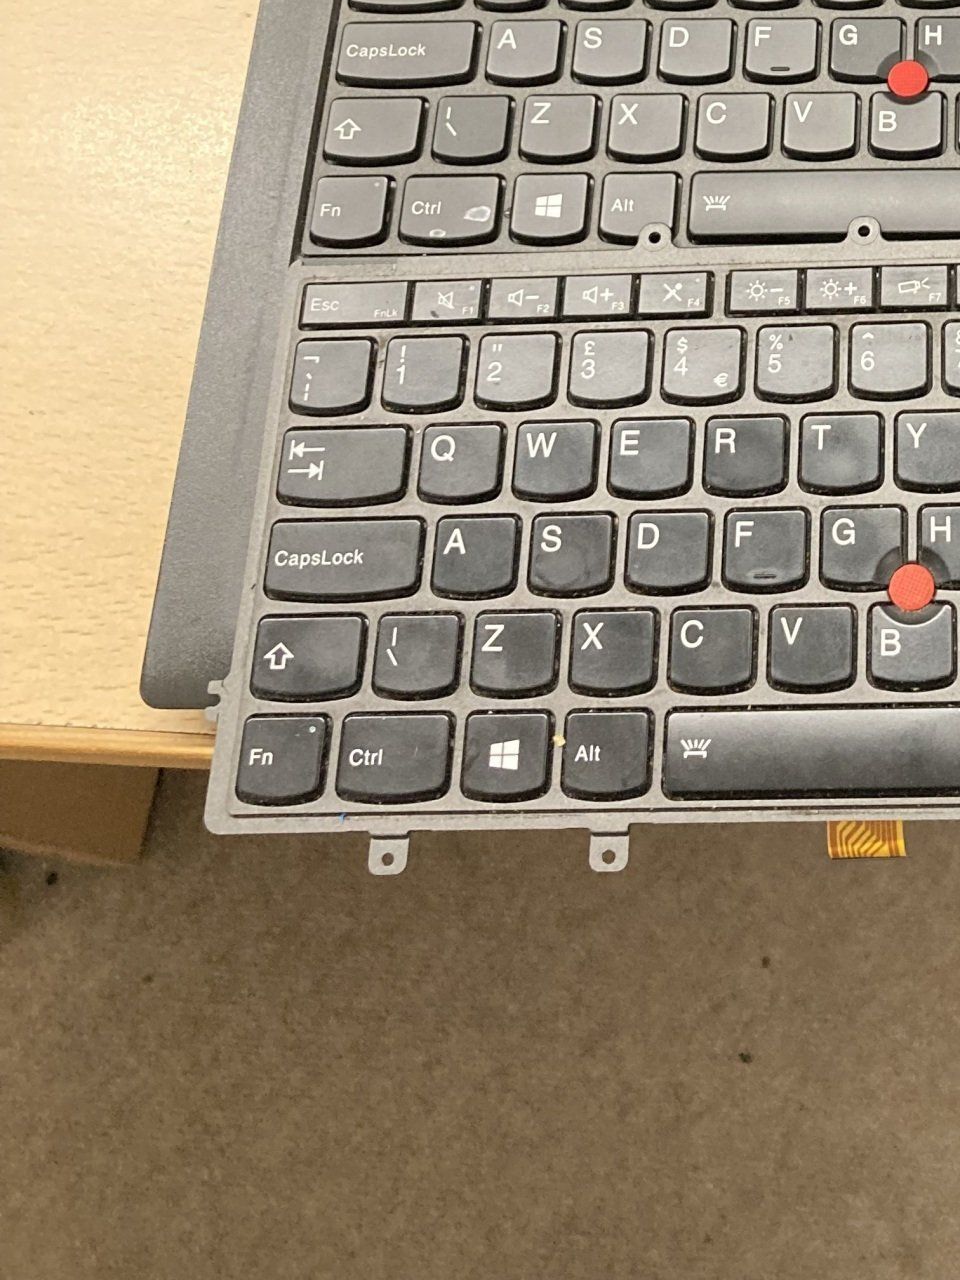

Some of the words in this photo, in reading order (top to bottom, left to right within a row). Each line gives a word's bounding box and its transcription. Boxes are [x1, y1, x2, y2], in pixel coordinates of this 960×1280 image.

[496, 28, 517, 50] A
[583, 27, 603, 49] S
[669, 26, 690, 48] D
[754, 26, 772, 47] F
[838, 24, 858, 46] G
[924, 24, 942, 46] H
[346, 43, 426, 60] CapsLock
[530, 102, 552, 124] Z
[618, 103, 639, 125] X
[705, 101, 727, 125] C
[793, 100, 813, 123] V
[878, 110, 897, 132] B
[319, 203, 341, 217] Fn
[411, 200, 442, 215] Ctrl
[610, 198, 634, 212] Alt
[310, 297, 340, 312] Esc
[536, 303, 550, 314] F2
[611, 301, 625, 311] F3
[687, 297, 700, 308] F4
[777, 295, 791, 306] F5
[853, 295, 867, 305] F6
[928, 292, 942, 303] F7
[373, 308, 398, 318] FnLk
[462, 306, 474, 315] F1
[584, 340, 596, 356] £
[676, 336, 689, 355] $
[768, 334, 784, 351] %
[399, 344, 407, 364] !
[767, 353, 782, 374] 5
[860, 350, 875, 372] 6
[396, 364, 406, 385] 1
[486, 361, 503, 382] 2
[580, 358, 596, 380] 3
[673, 356, 689, 376] 4
[713, 372, 729, 388] €
[526, 431, 557, 458] W
[619, 429, 641, 456] E
[714, 427, 736, 454] R
[810, 424, 832, 451] T
[905, 422, 927, 449] Y
[430, 434, 456, 462] Q
[540, 524, 562, 553] S
[637, 522, 660, 550] D
[734, 520, 755, 548] F
[831, 517, 856, 546] G
[930, 515, 951, 543] H
[442, 528, 466, 555] A
[274, 548, 364, 570] CapsLock
[481, 624, 505, 652] Z
[580, 622, 604, 650] X
[680, 619, 704, 649] C
[780, 616, 803, 645] V
[880, 628, 902, 657] B
[248, 748, 274, 766] Fn
[348, 748, 384, 767] Ctrl
[574, 744, 601, 762] Alt
